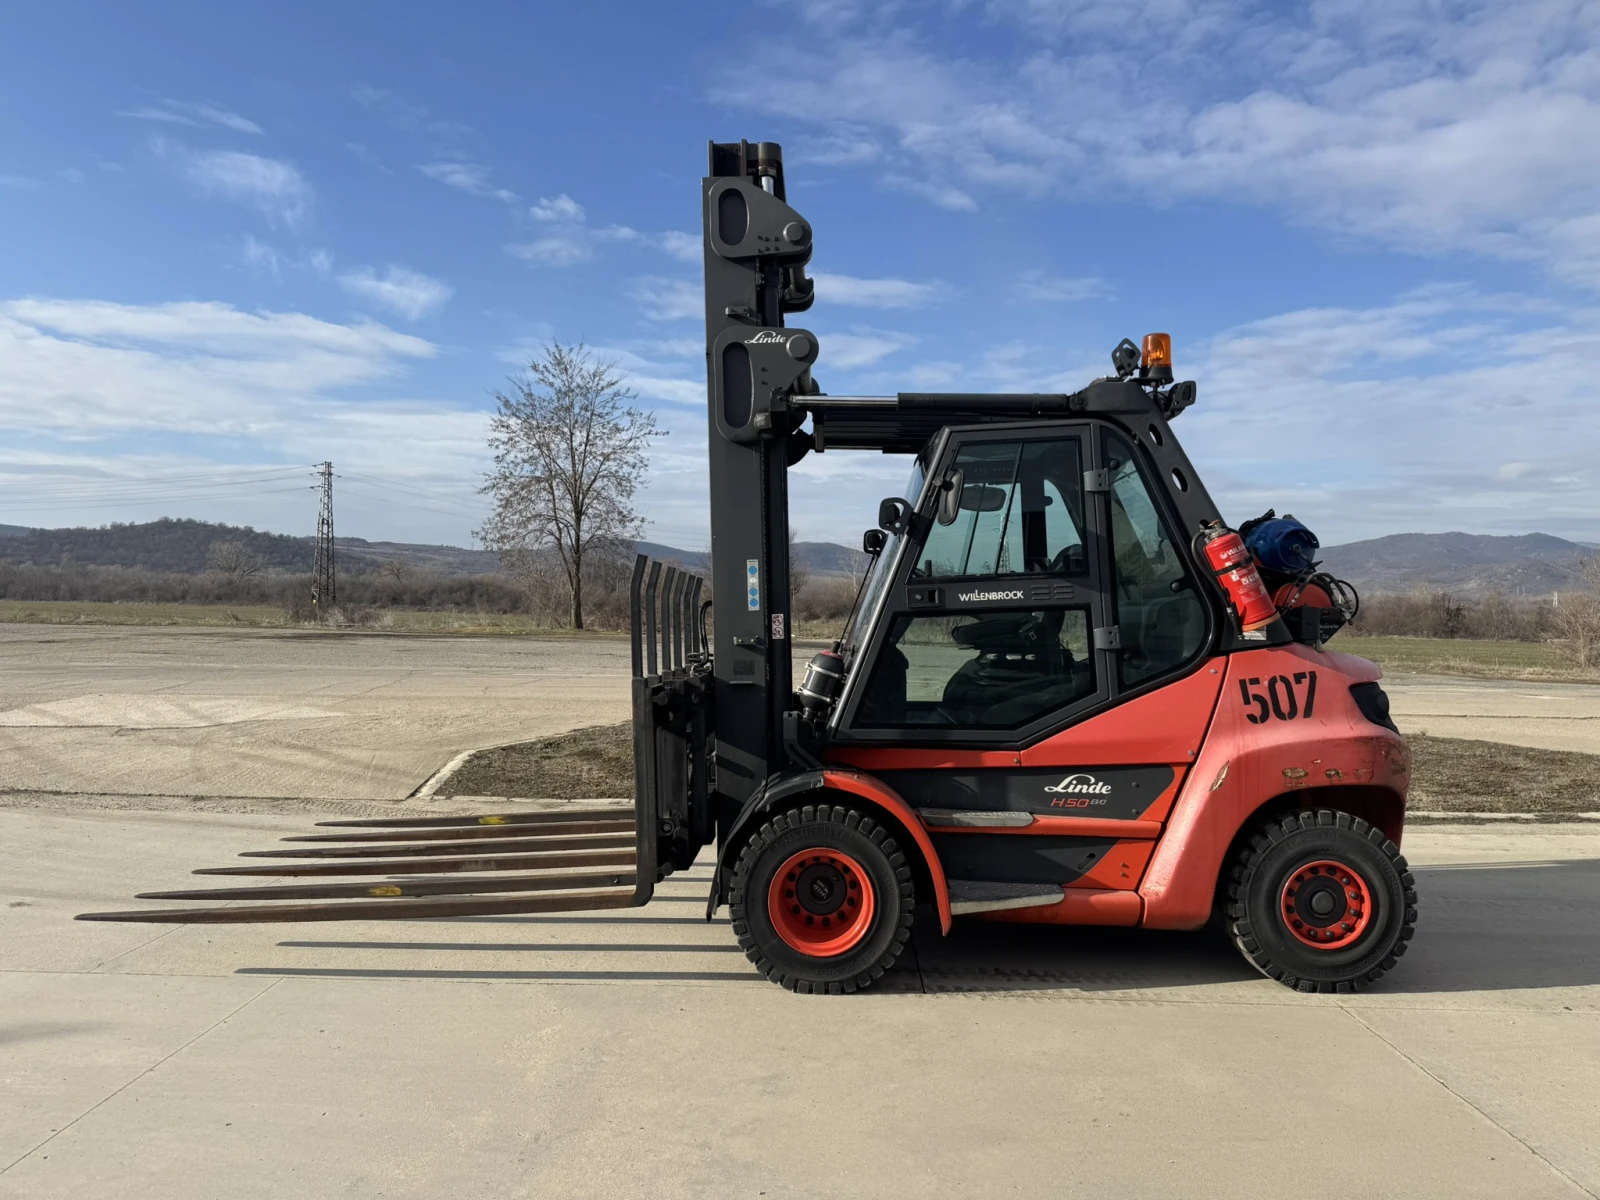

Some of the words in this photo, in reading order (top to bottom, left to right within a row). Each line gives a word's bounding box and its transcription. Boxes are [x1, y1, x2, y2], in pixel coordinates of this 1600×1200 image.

[744, 330, 786, 344] Linde
[959, 589, 1024, 602] WILLENBROCK
[1239, 670, 1317, 724] 507
[1044, 773, 1112, 794] Linde
[1050, 798, 1090, 808] H50
[1090, 798, 1107, 806] EVO
